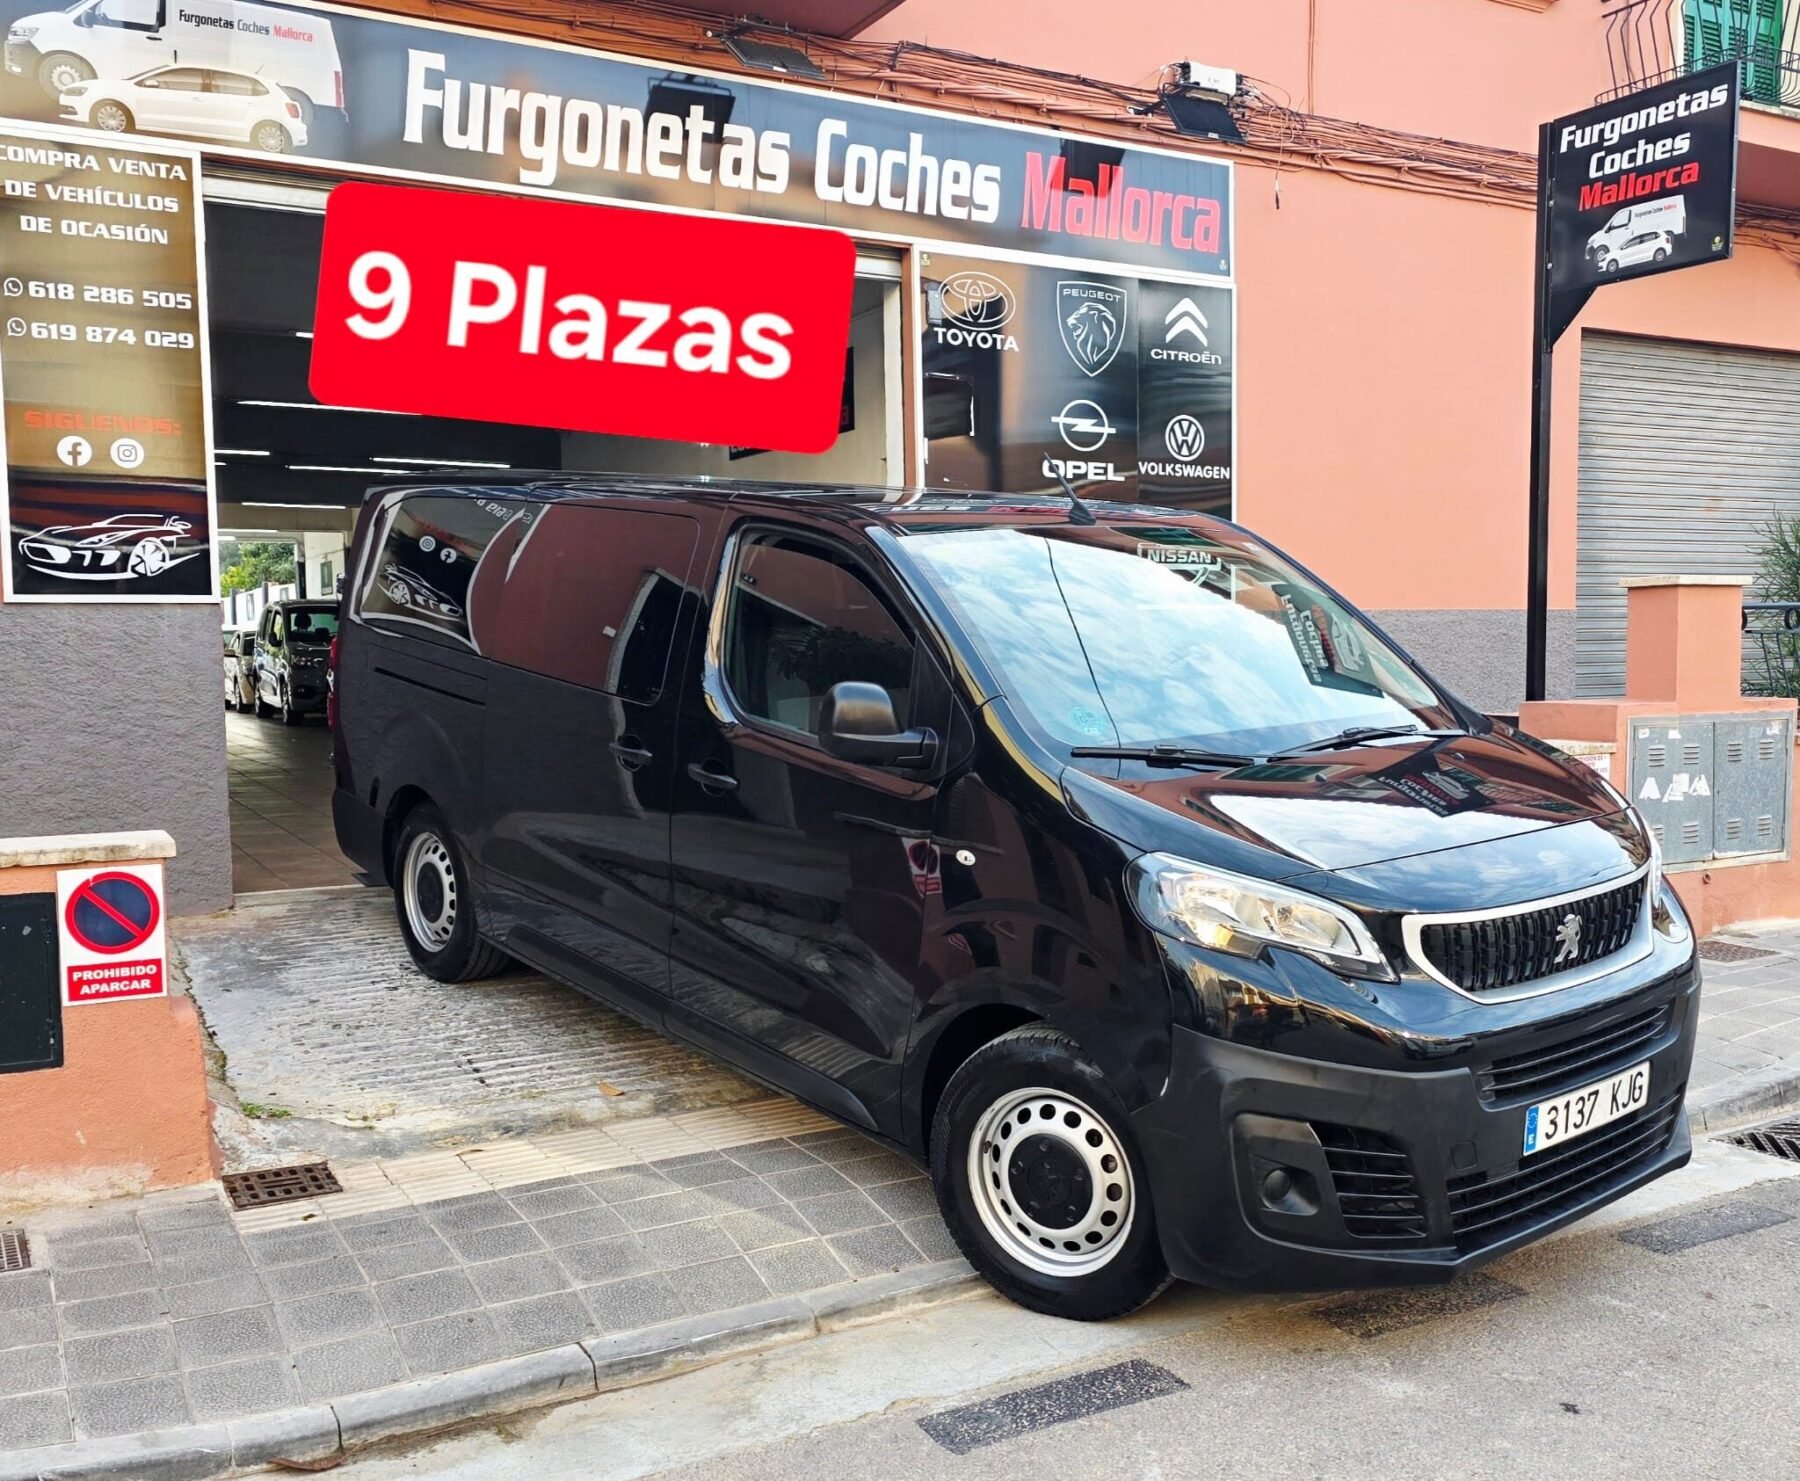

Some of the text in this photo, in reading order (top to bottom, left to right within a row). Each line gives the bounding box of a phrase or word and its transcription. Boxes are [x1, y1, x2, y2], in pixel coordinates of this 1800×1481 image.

[179, 9, 313, 42] Furgonetas Coches Mallorca
[1559, 83, 1729, 153] Furgonetas
[402, 48, 1221, 253] Furgonetas Coches Mallorca
[1589, 132, 1691, 179] Coches
[108, 157, 188, 181] VENTA
[5, 179, 179, 212] DE VEHÍCULOS
[1578, 162, 1700, 211] Mallorca
[20, 215, 168, 245] DE OCASIÓN
[28, 281, 192, 310] 618 286 505
[1063, 288, 1122, 303] PEUGEOT
[30, 322, 194, 349] 619 874 029
[933, 327, 1020, 352] TOYOTA
[1042, 459, 1126, 481] OPEL
[1138, 461, 1230, 480] VOLKSWAGEN
[1147, 549, 1212, 563] NISSAN
[72, 964, 157, 981] PROHIBIDO
[80, 978, 151, 995] APARCAR
[1545, 1071, 1643, 1140] 3137 KJG
